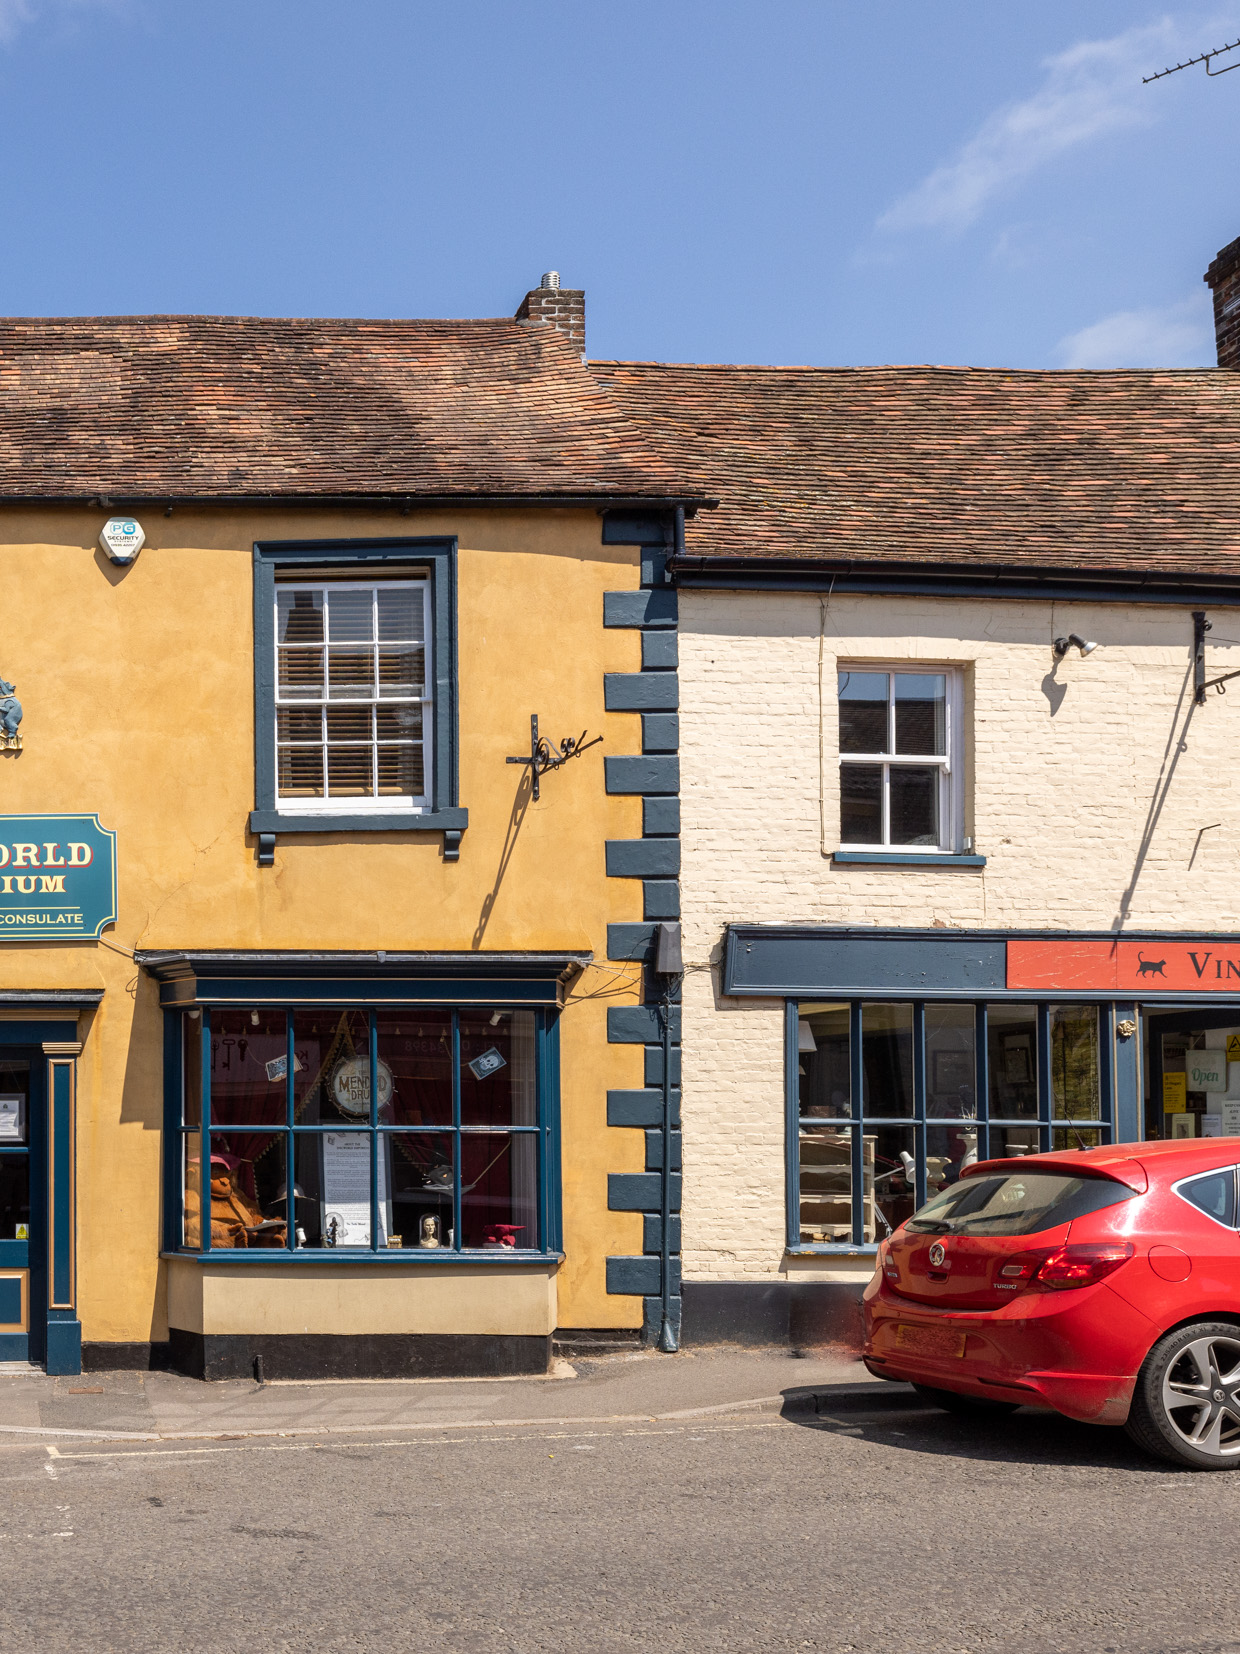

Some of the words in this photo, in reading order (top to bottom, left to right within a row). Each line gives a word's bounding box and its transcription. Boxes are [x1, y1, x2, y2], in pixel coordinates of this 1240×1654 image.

[111, 523, 136, 534] PG
[338, 1075, 388, 1093] MENDD
[1192, 1068, 1219, 1086] Open
[351, 1090, 371, 1100] DRU
